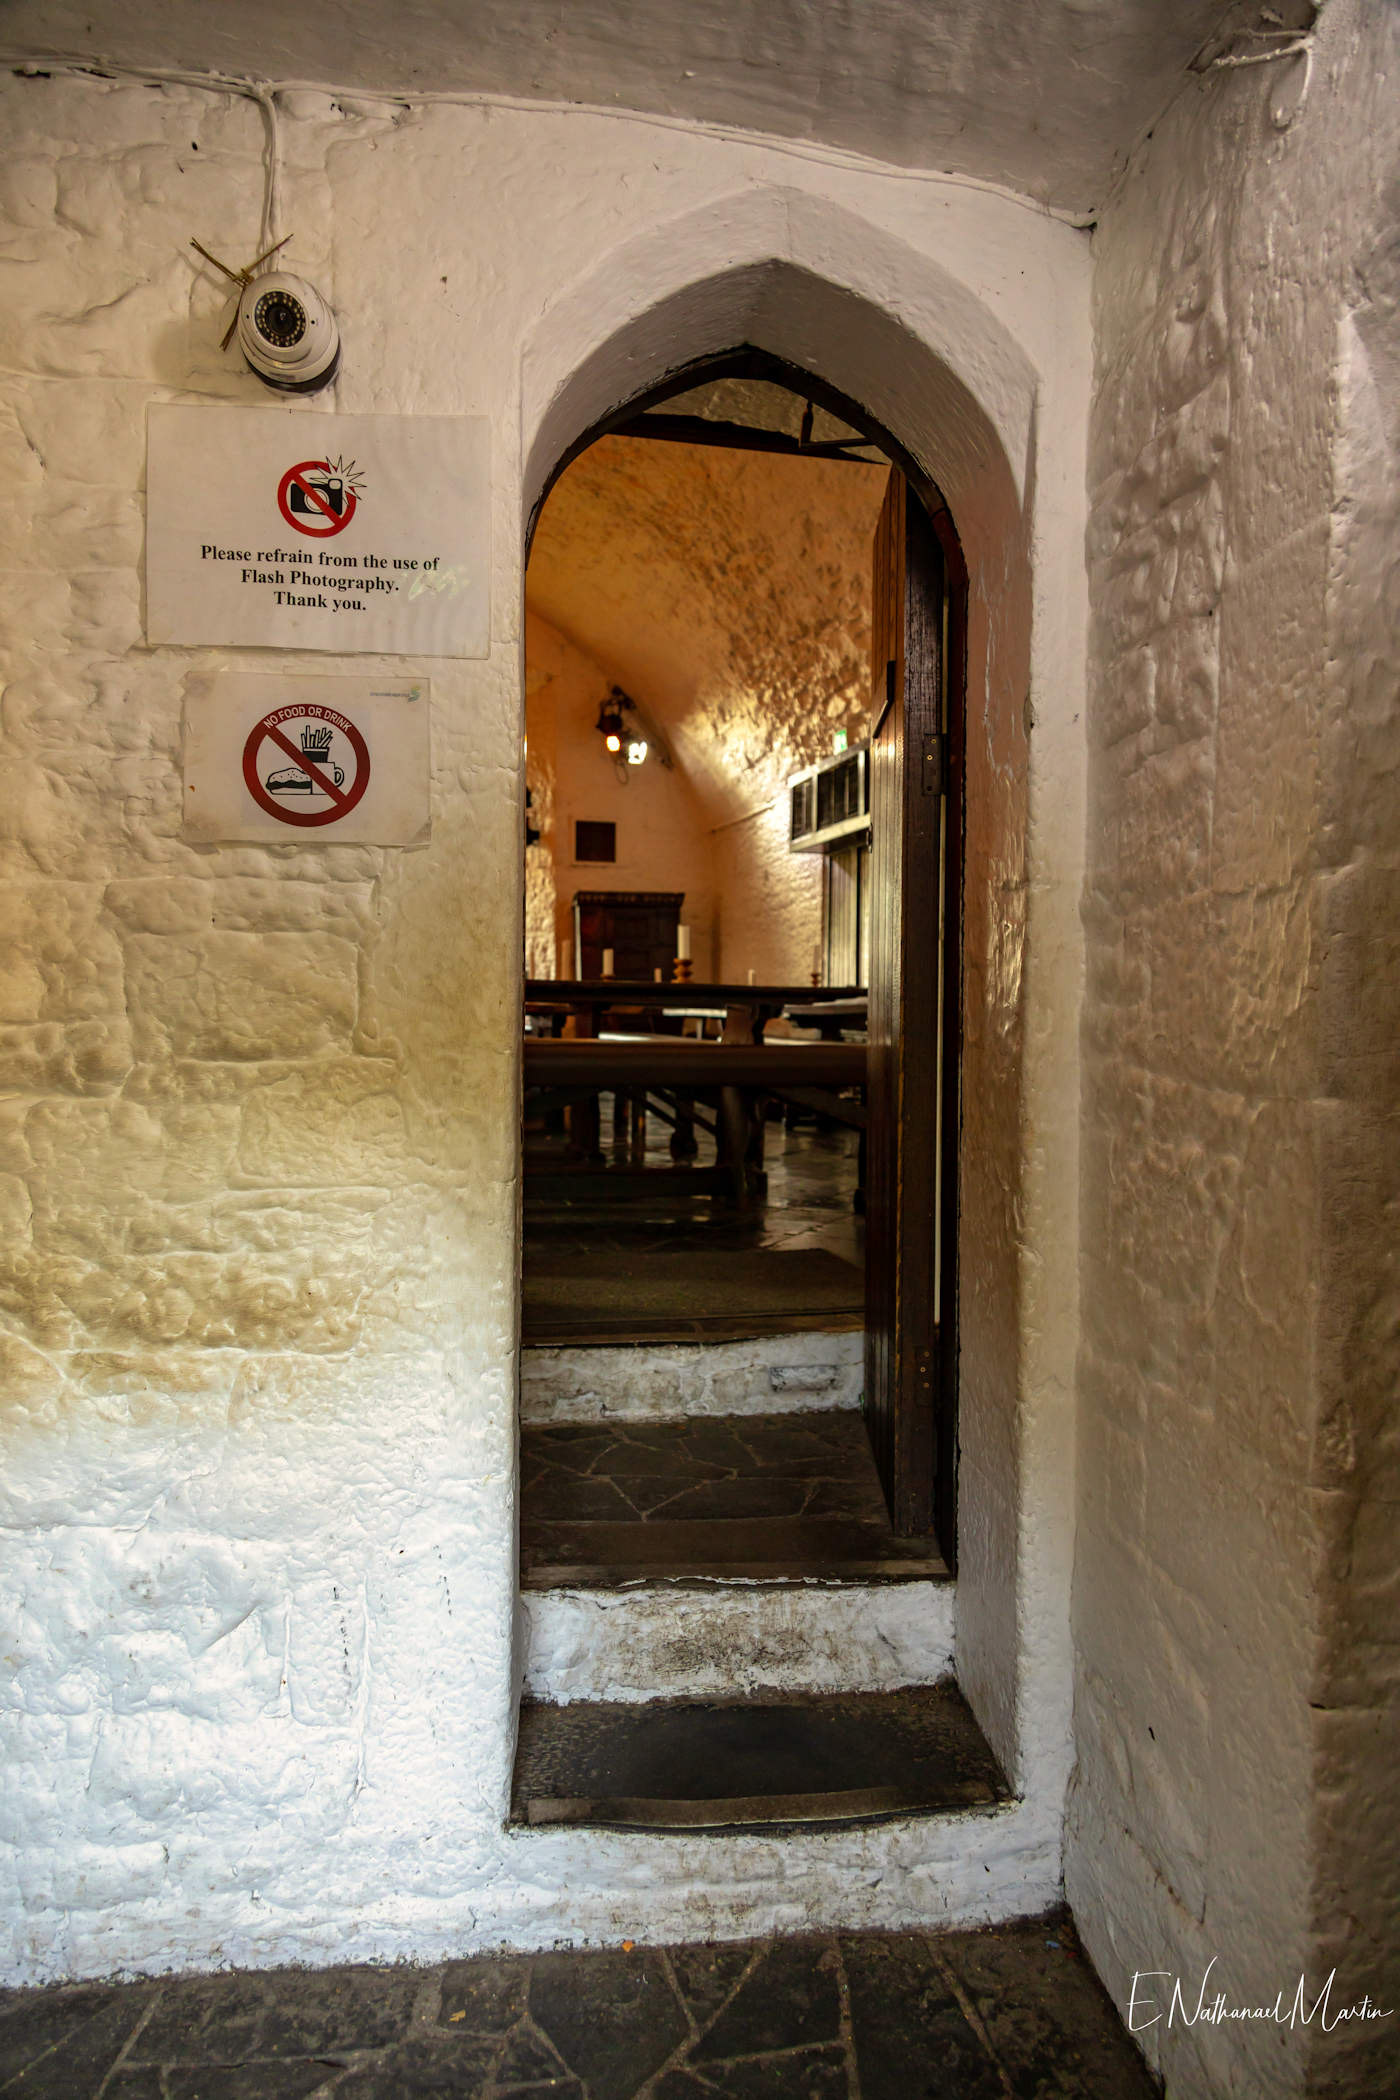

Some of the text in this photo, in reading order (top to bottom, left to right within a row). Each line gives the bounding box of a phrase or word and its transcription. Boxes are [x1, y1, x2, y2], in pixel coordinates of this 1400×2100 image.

[201, 545, 440, 571] Please refrain from the use of
[241, 569, 399, 594] Flash Photography.
[274, 591, 367, 613] Thank you.
[263, 706, 352, 732] NO FOOD OR DRINK
